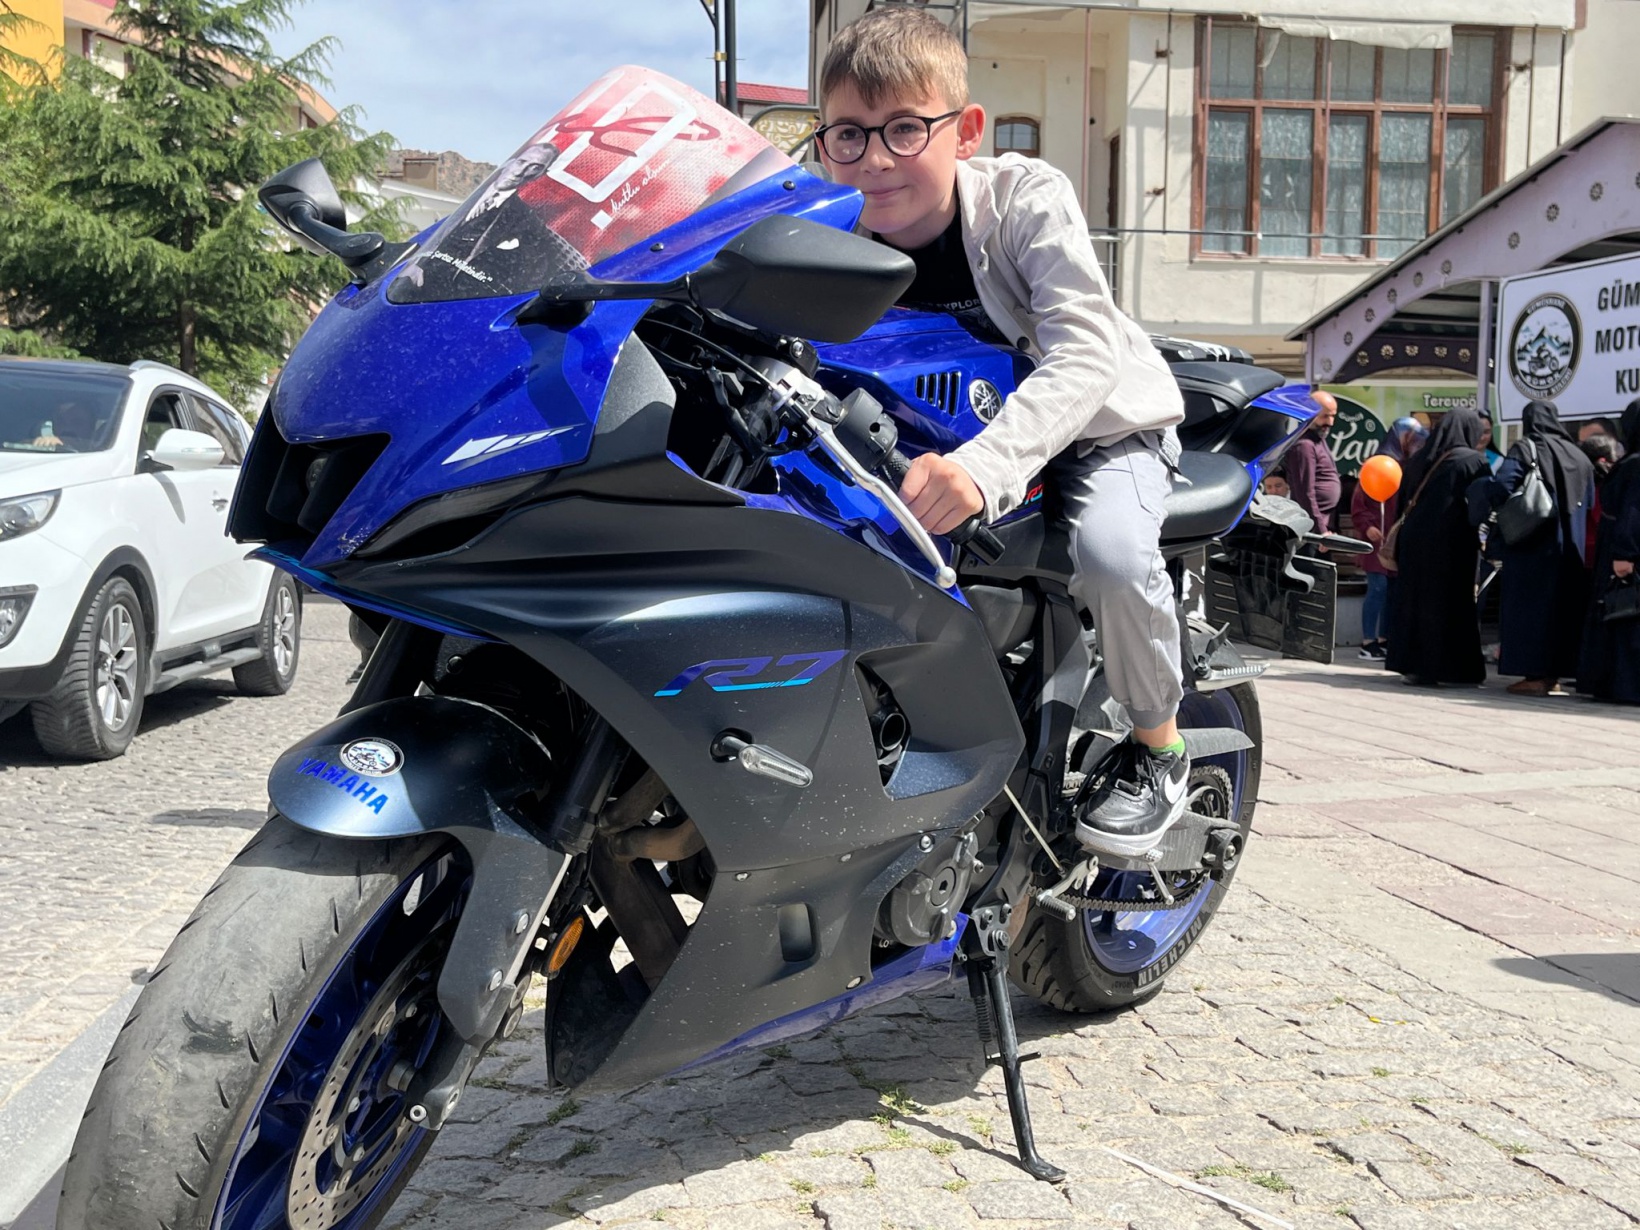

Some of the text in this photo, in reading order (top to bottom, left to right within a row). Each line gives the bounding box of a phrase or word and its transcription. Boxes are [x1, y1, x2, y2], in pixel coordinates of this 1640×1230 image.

[653, 649, 850, 697] R7
[296, 757, 389, 815] YAMAHA
[1137, 915, 1203, 987] MICHELIN
